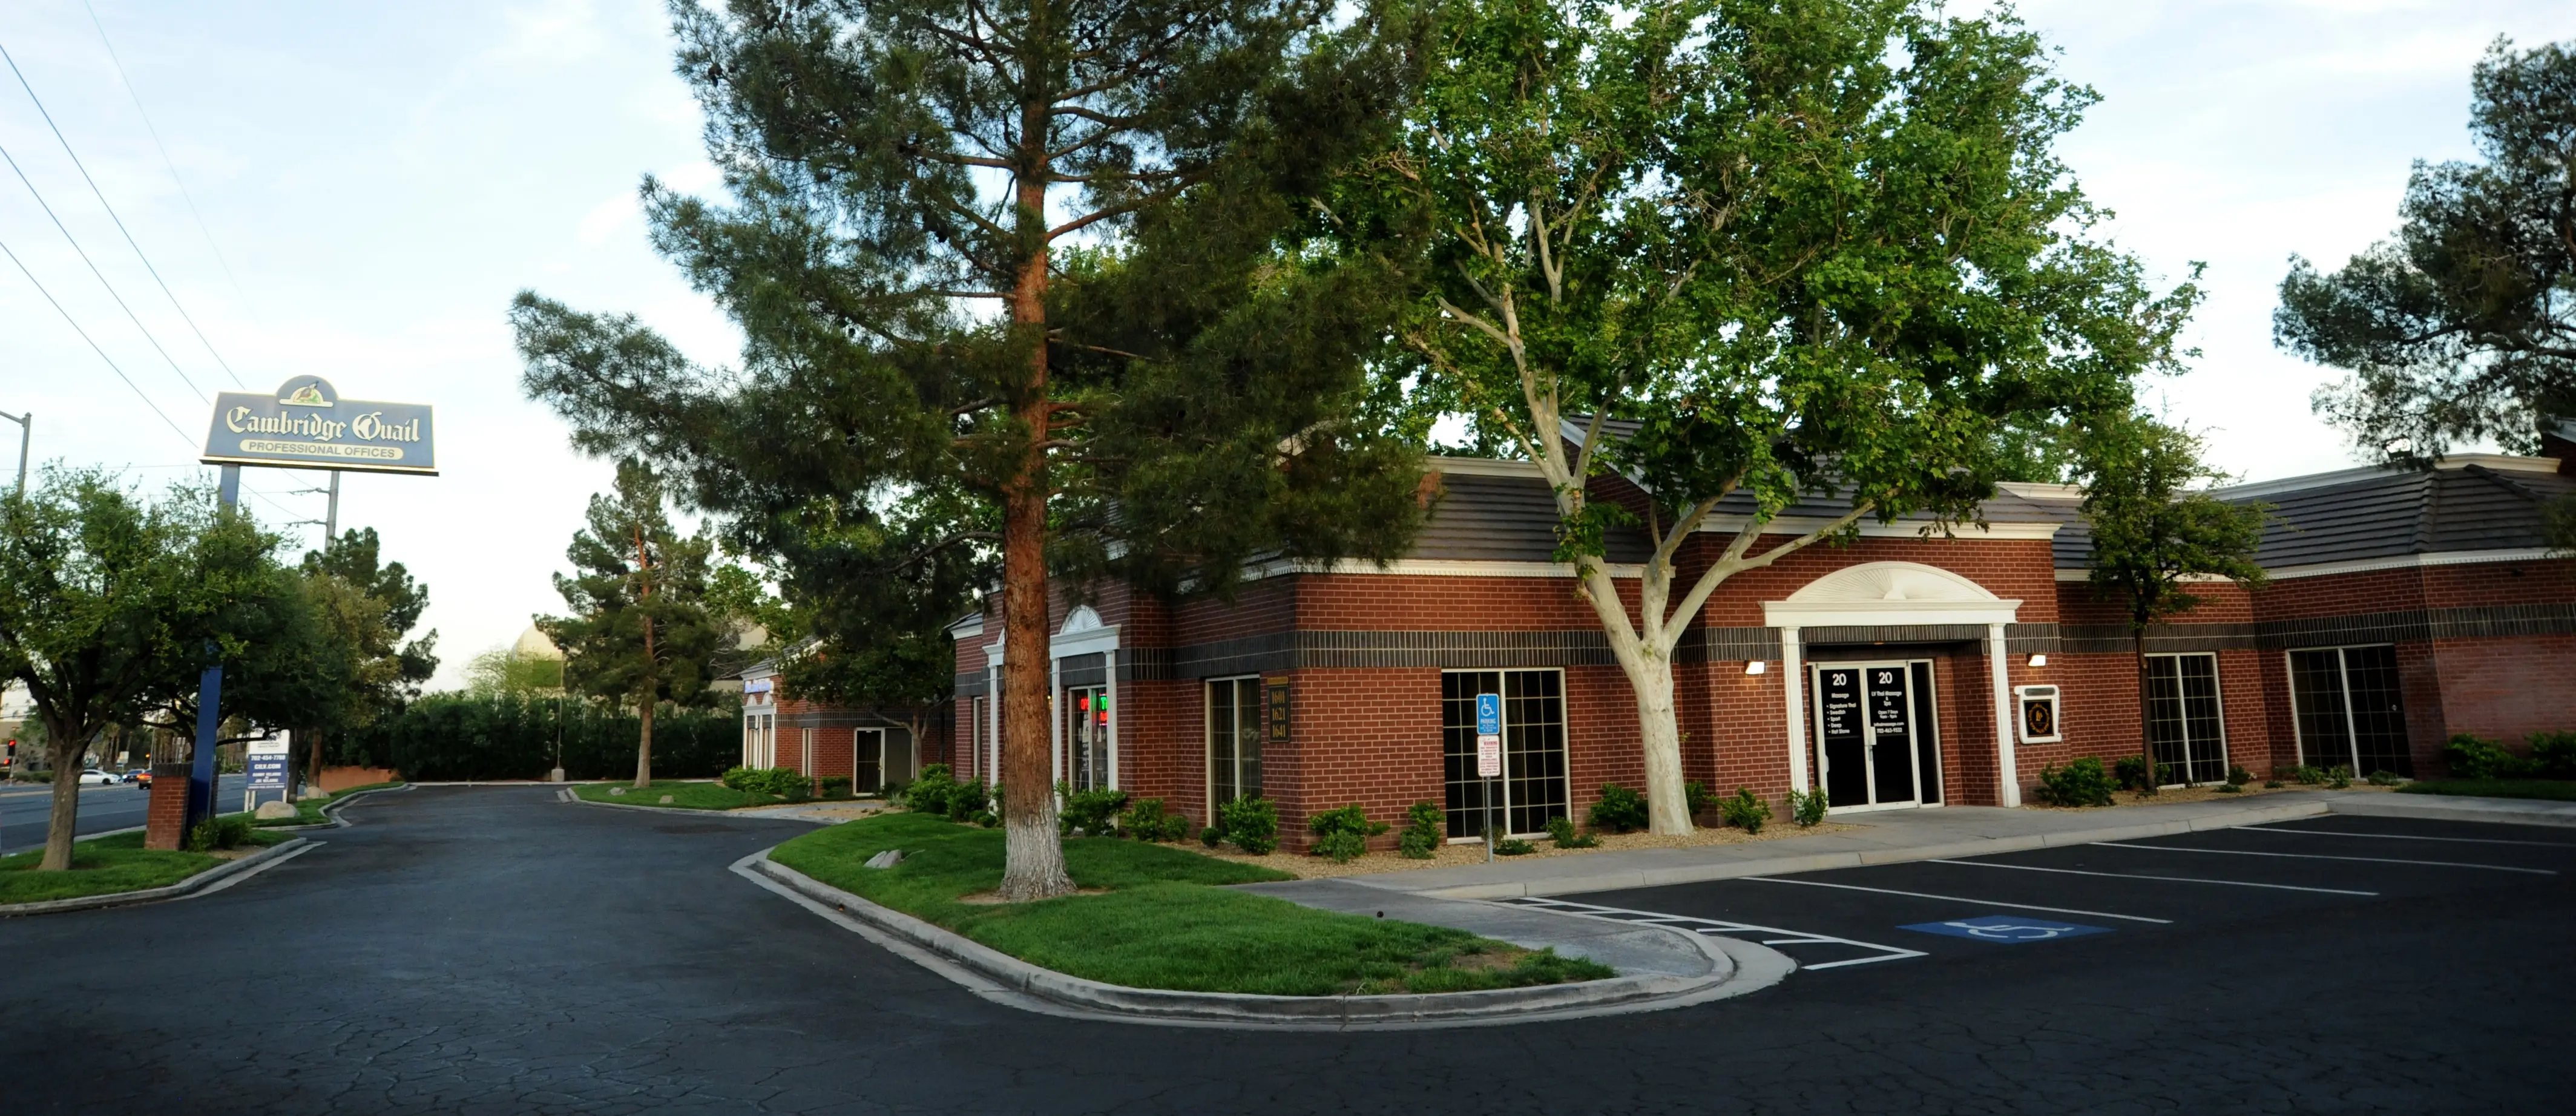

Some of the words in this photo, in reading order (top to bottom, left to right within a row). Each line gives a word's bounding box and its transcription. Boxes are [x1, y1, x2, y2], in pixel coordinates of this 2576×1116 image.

[226, 405, 348, 443] Cambridge
[352, 411, 421, 442] Quail
[249, 441, 341, 456] PROFESSIONAL
[344, 447, 395, 458] OFFICES
[1832, 673, 1847, 686] 20
[1878, 672, 1893, 684] 20
[1272, 690, 1285, 704] 1601
[1272, 707, 1286, 721] 1621
[1272, 723, 1286, 738] 1641
